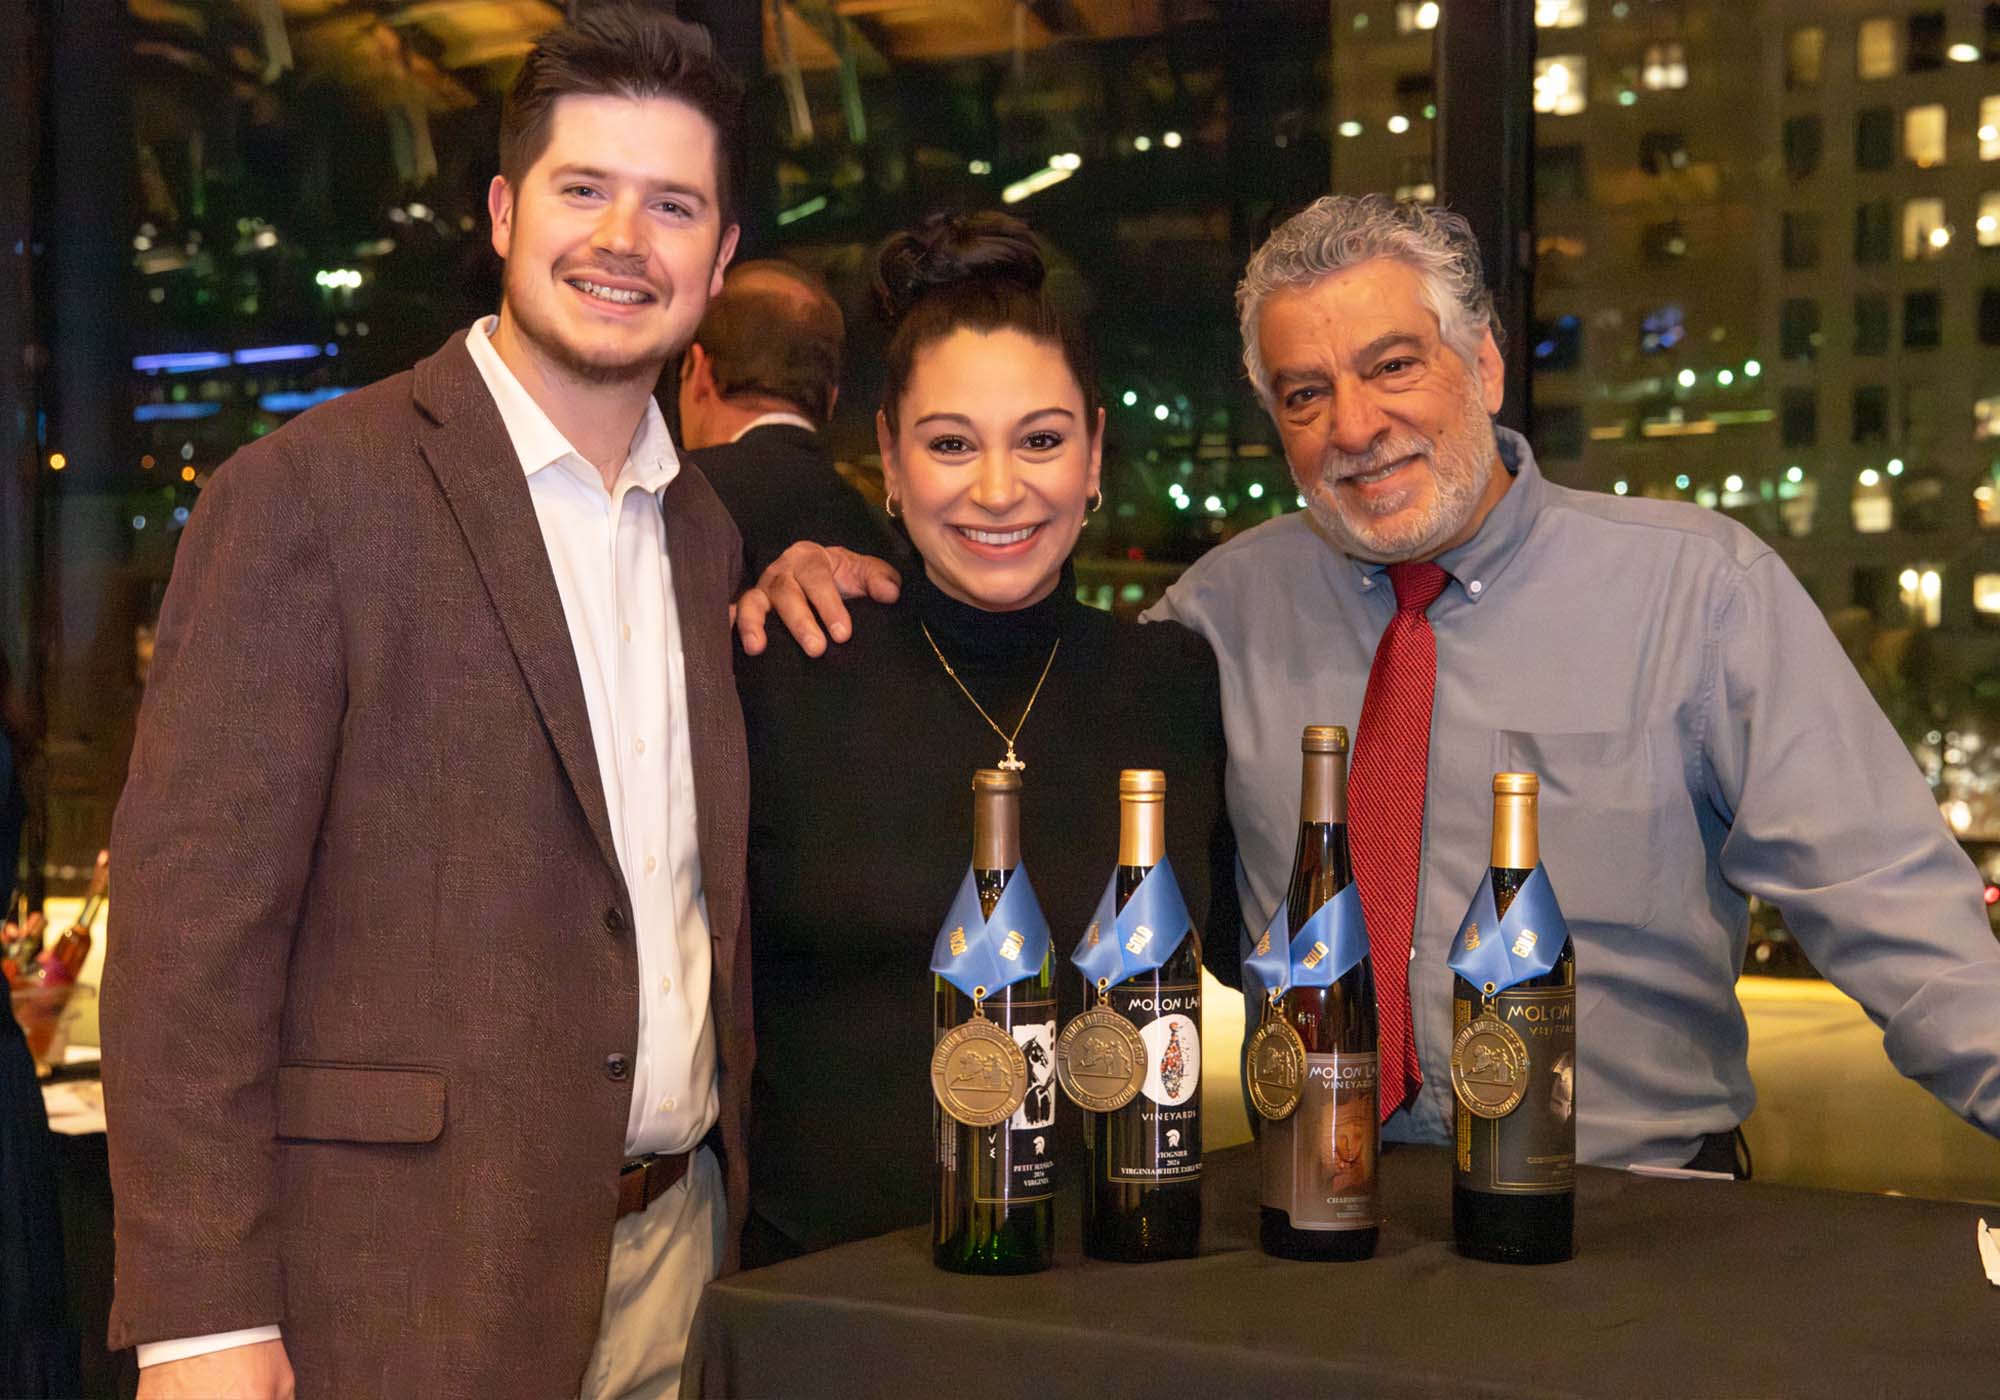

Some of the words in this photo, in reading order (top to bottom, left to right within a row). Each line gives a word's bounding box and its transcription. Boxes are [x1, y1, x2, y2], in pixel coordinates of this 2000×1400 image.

[999, 930, 1025, 960] GOLD
[1125, 925, 1153, 955] GOLD
[1511, 928, 1538, 958] GOLD
[1302, 941, 1330, 970] GOLD
[1128, 997, 1182, 1011] MOLON
[1506, 1002, 1570, 1022] MOLON
[1309, 1066, 1362, 1079] MOLON
[1120, 1167, 1156, 1175] VIRGINIA
[1156, 1166, 1180, 1175] WHITE
